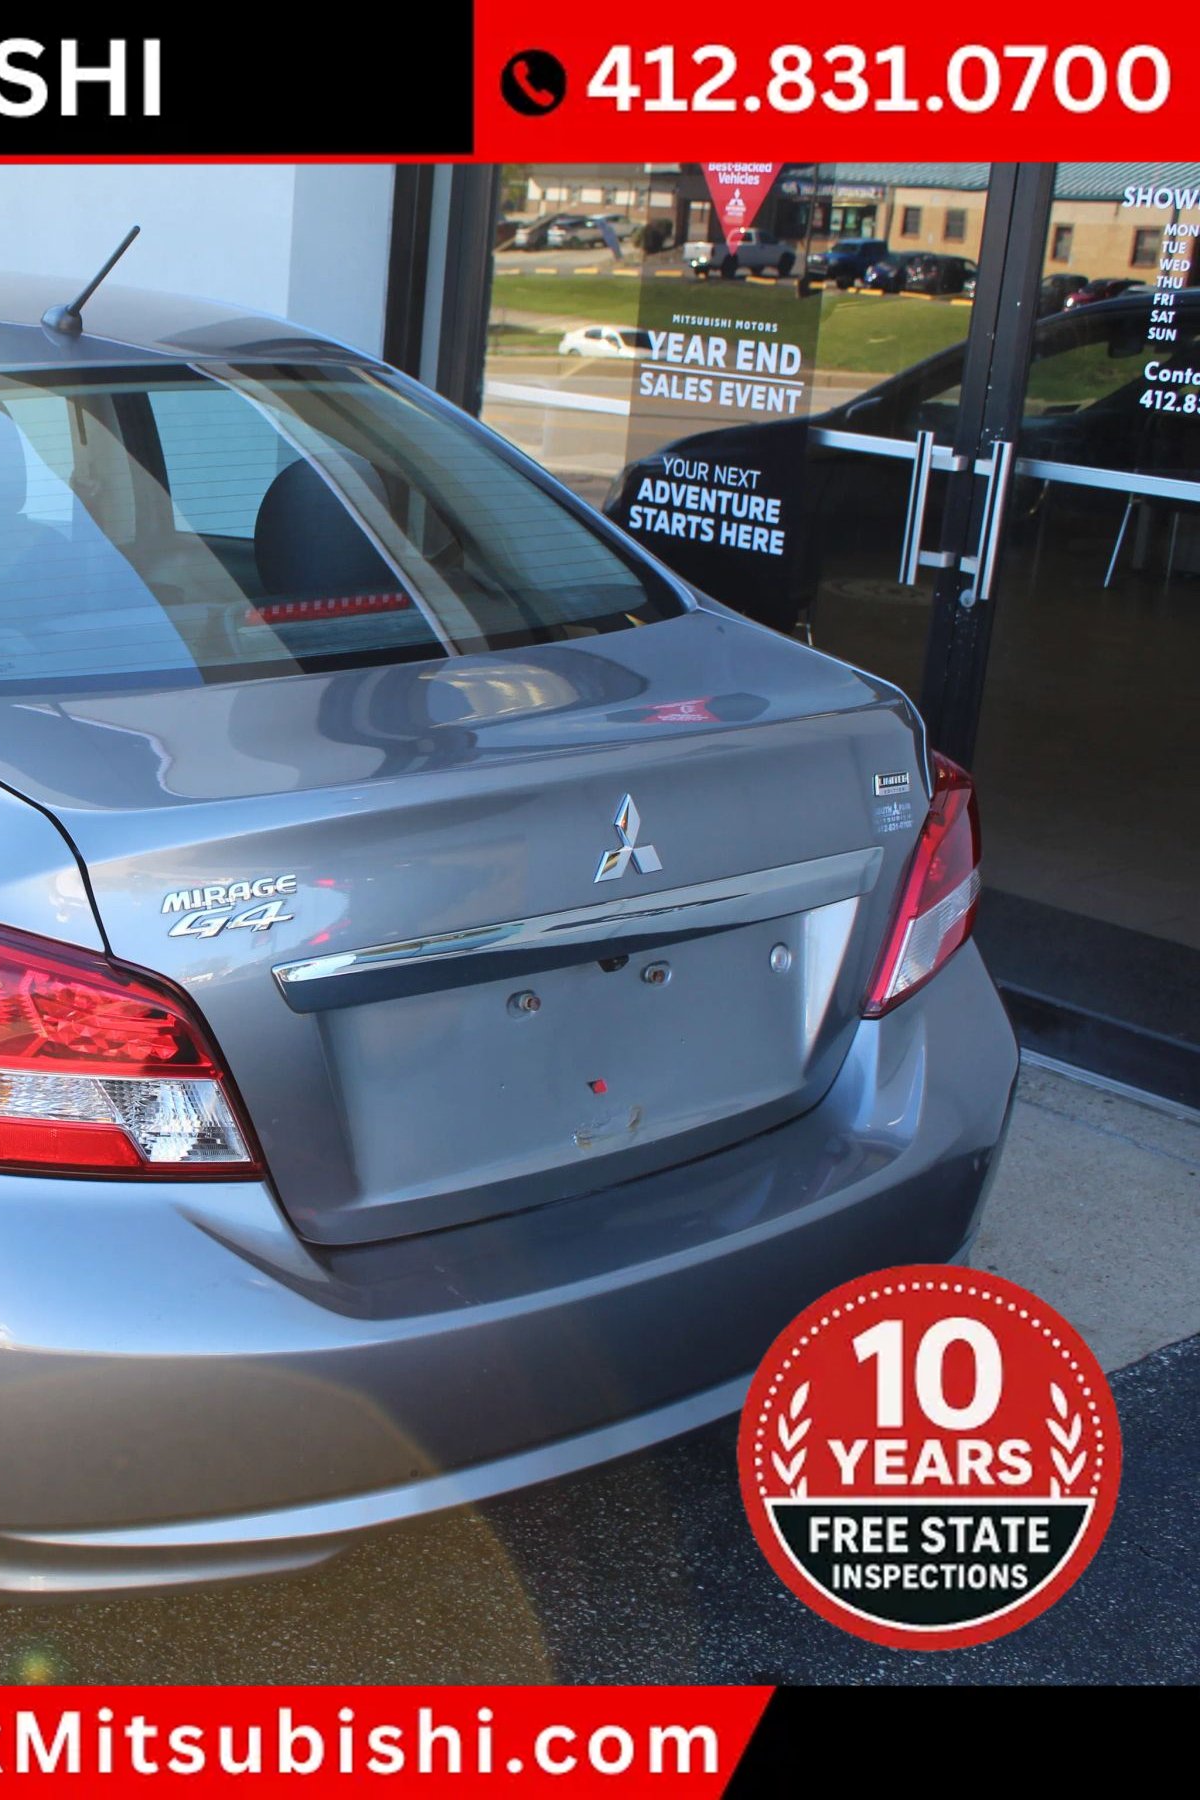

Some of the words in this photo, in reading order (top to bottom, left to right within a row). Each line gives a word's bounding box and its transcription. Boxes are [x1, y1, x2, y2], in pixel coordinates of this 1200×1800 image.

[718, 172, 760, 185] Vehicles
[1121, 186, 1200, 210] SHOW
[1164, 224, 1199, 237] MON
[1161, 241, 1188, 254] TUE
[1160, 258, 1191, 272] WED
[1156, 275, 1184, 289] THU
[1153, 292, 1175, 306] FRI
[672, 314, 732, 329] MITSUBISHI
[735, 319, 778, 333] MOTORS
[1150, 309, 1176, 324] SAT
[1147, 326, 1177, 341] SUN
[648, 330, 728, 369] YEAR
[736, 339, 801, 376] END
[639, 372, 713, 404] SALES
[719, 381, 802, 414] EVENT
[663, 456, 709, 482] YOUR
[714, 465, 761, 489] NEXT
[637, 477, 782, 524] ADVENTURE
[629, 504, 715, 543] STARTS
[720, 521, 785, 556] HERE
[161, 874, 297, 914] MIRAGE
[168, 900, 295, 939] G4
